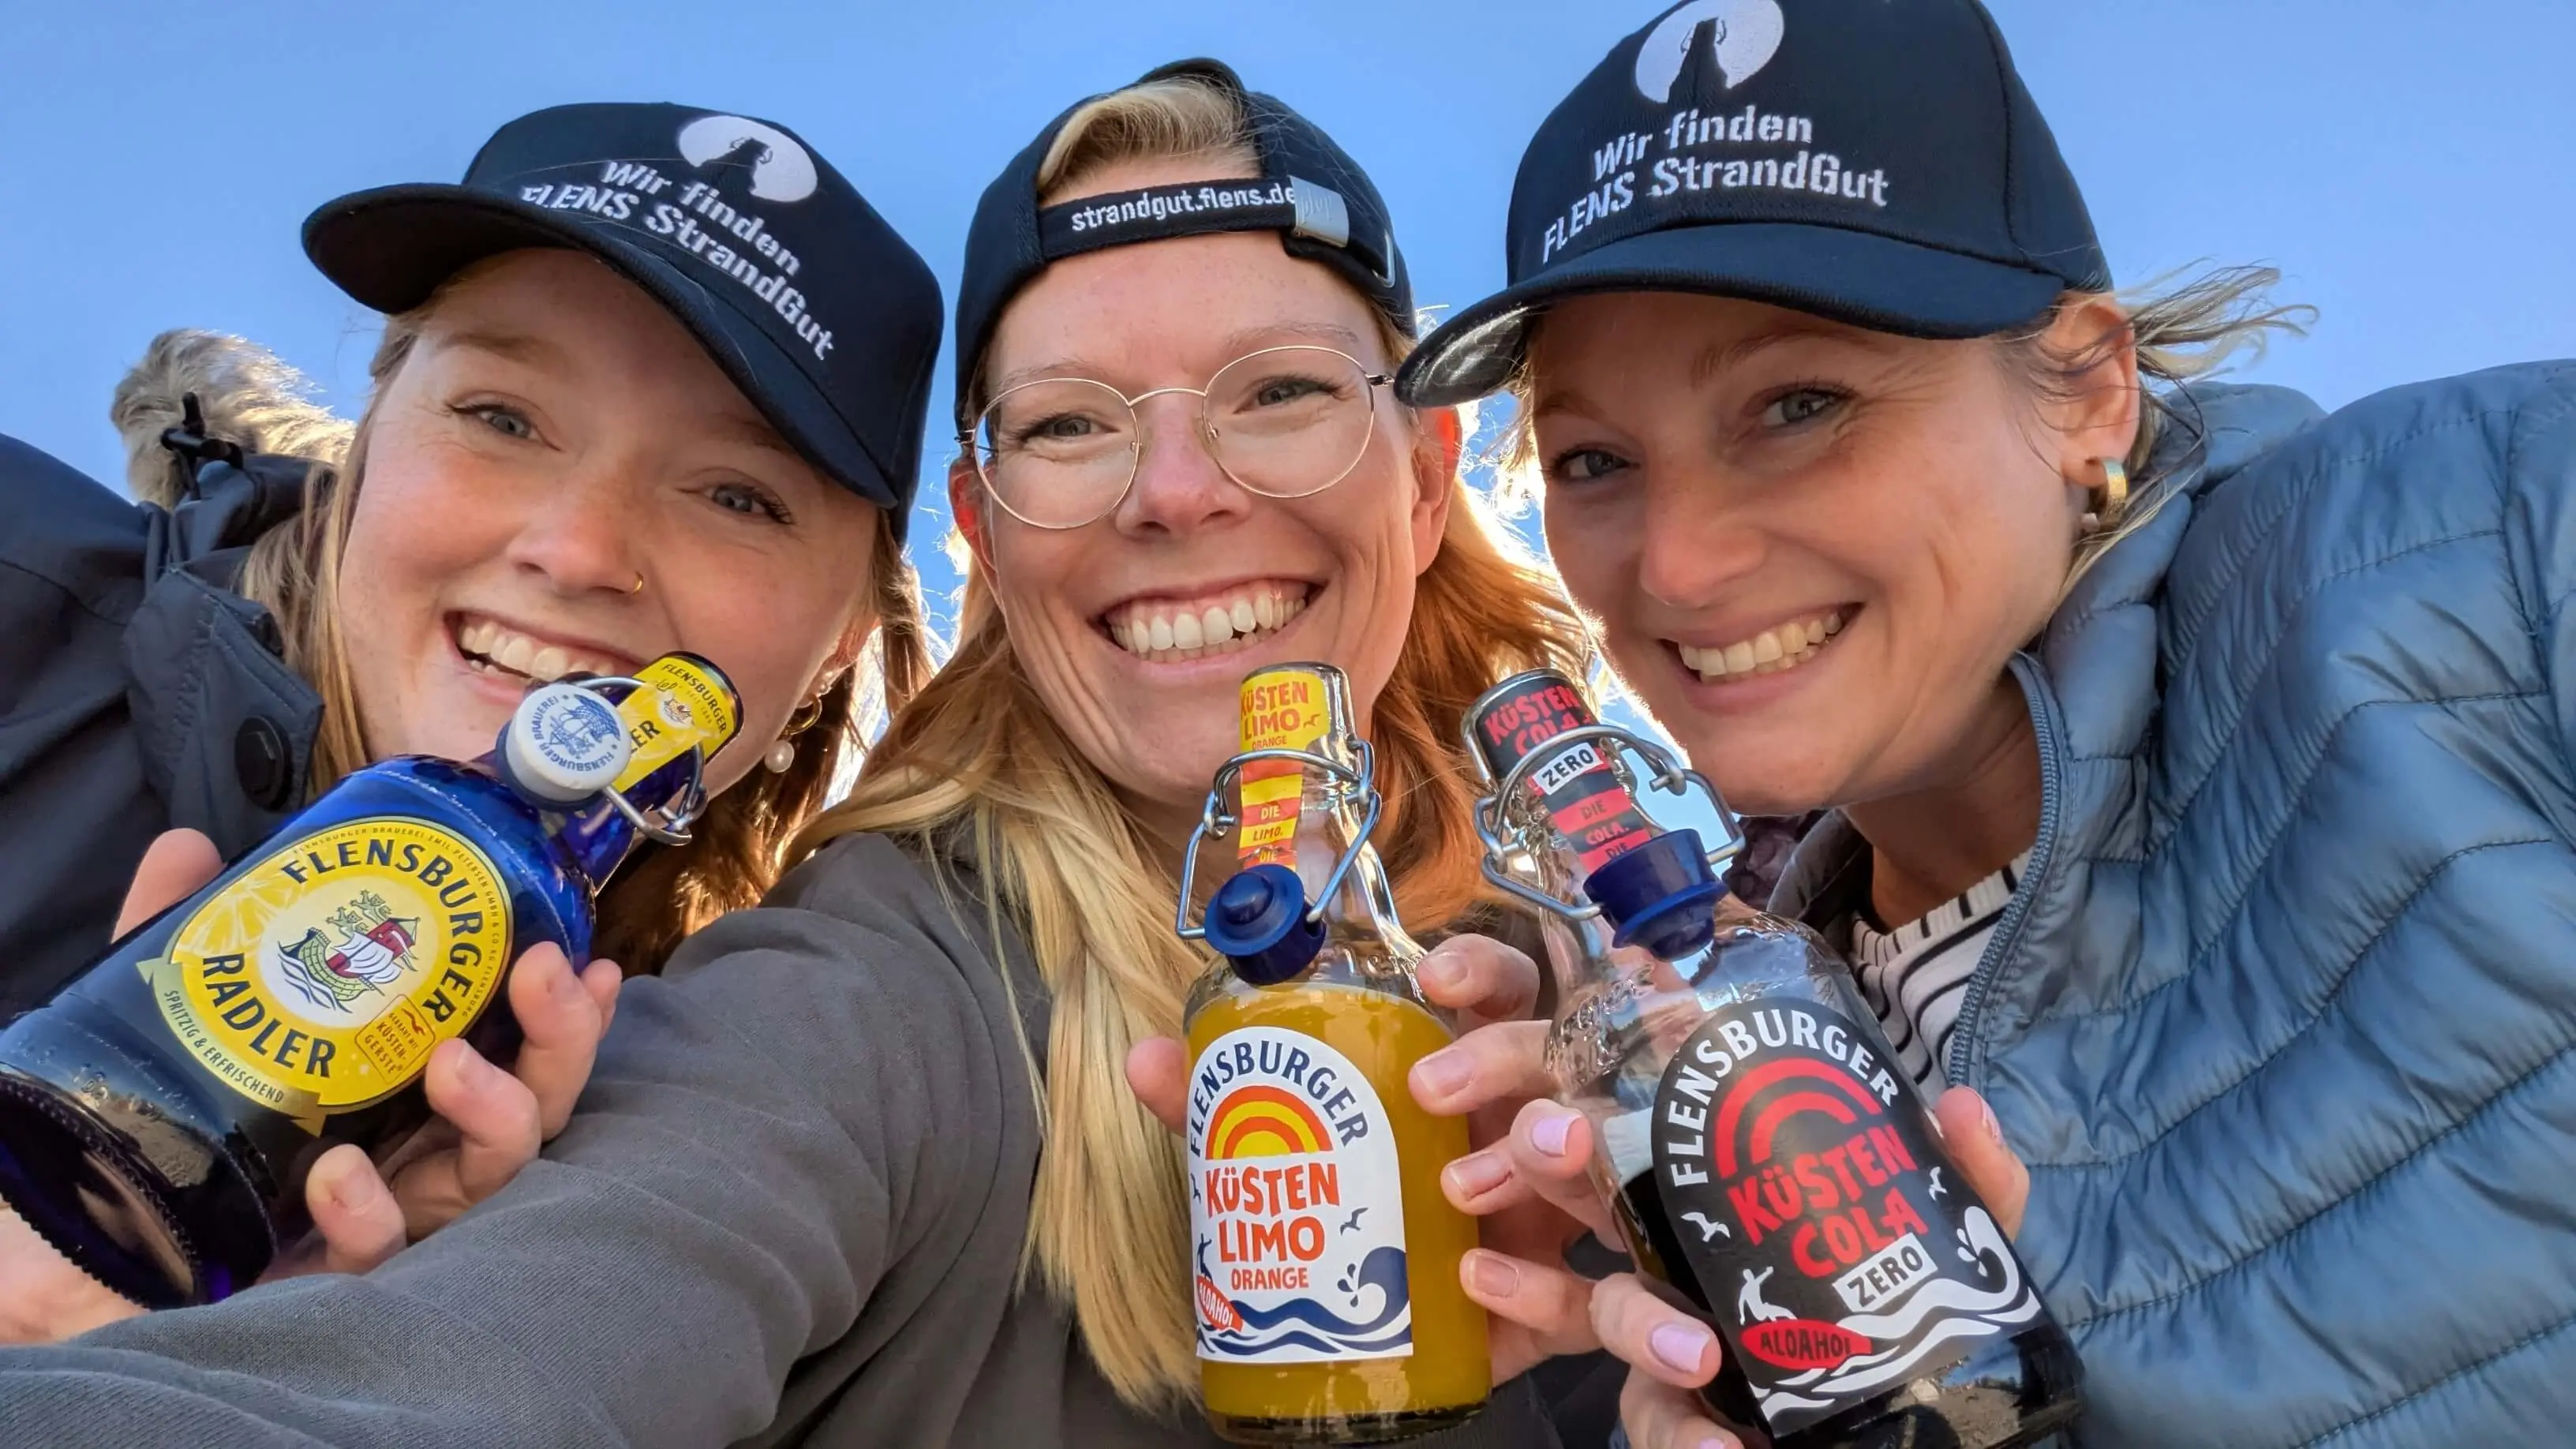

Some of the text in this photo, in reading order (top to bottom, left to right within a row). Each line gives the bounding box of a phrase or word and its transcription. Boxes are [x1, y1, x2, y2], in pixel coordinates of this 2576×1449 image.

[1593, 105, 1813, 182] Wir finden
[600, 160, 802, 276] Wir finden
[1071, 182, 1295, 231] strandgut.flens.de
[1542, 151, 1889, 264] FLENS StrandGut
[644, 204, 834, 361] StrandGut
[531, 695, 616, 772] FLENSBURGER BRAUEREI
[661, 664, 727, 734] FLENSBURGER
[1245, 709, 1301, 740] LIMO
[1485, 685, 1580, 746] KÜSTEN
[1541, 749, 1594, 788] ZERO
[1260, 805, 1280, 820] DIE
[1581, 800, 1607, 819] DIE
[281, 839, 484, 1023] FLENSBURGER
[164, 990, 285, 1103] SPRITZIG & ERFRISCHEND
[202, 953, 336, 1078] RADLER
[1190, 1039, 1369, 1158] FLENSBURGER
[1668, 1009, 1900, 1187] FLENSBURGER
[1205, 1163, 1340, 1219] KÜSTEN
[1726, 1125, 1918, 1246] KÜSTEN
[1218, 1215, 1326, 1263] LIMO
[1792, 1188, 1929, 1279] COLA
[1231, 1267, 1309, 1290] ORANGE
[1847, 1245, 1924, 1308] ZERO
